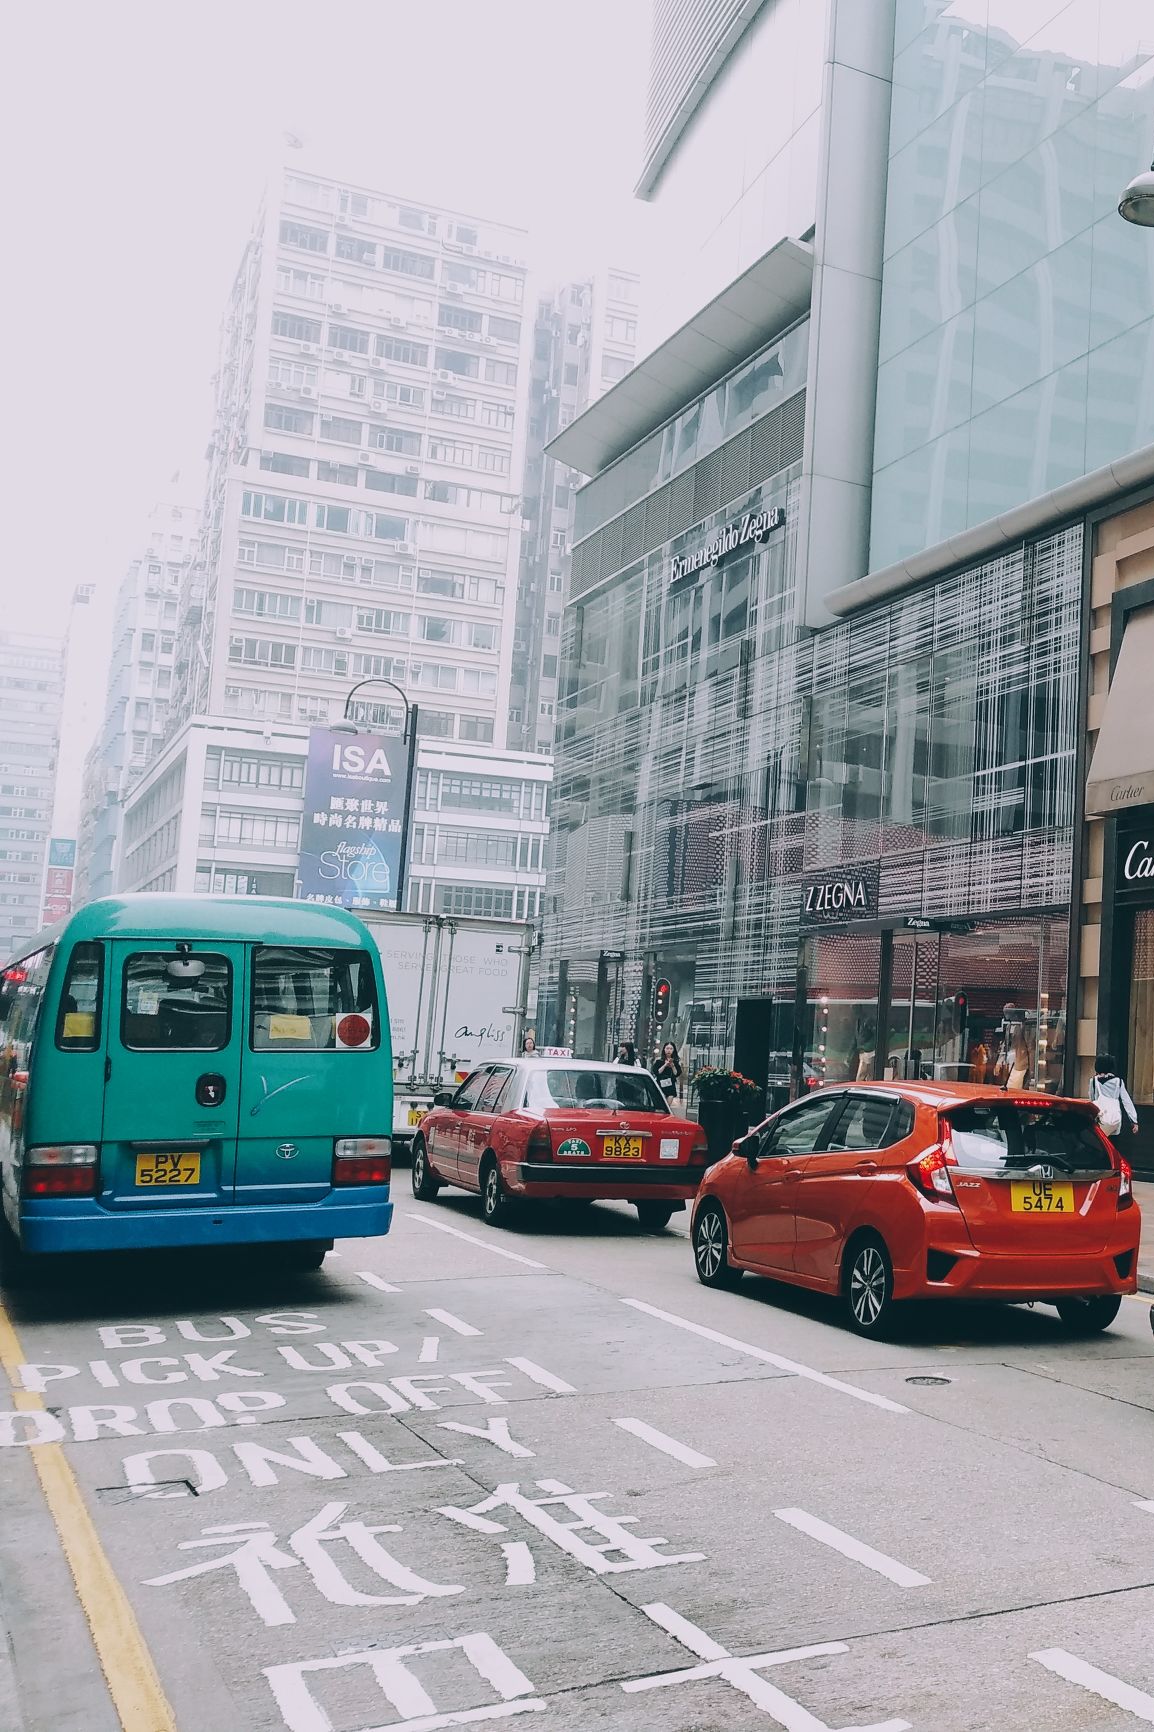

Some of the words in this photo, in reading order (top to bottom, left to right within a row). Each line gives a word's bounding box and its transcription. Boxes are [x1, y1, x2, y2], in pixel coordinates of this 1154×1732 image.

[670, 524, 739, 584] Ermenegildo
[739, 506, 779, 543] Zegna
[332, 744, 392, 776] ISA
[1110, 785, 1145, 802] Cartier
[335, 842, 376, 859] flagship
[319, 850, 390, 883] Store
[805, 886, 815, 911] Z
[816, 881, 866, 911] ZEGNA
[907, 917, 930, 928] Zegna
[483, 957, 508, 967] WHO
[478, 967, 508, 977] FOOD
[547, 1048, 570, 1057] TAXI
[571, 1143, 578, 1151] 5
[613, 1136, 632, 1147] KX
[604, 1146, 641, 1157] 9823
[155, 1155, 183, 1169] PV
[140, 1168, 196, 1184] 5227
[1032, 1181, 1053, 1197] UE
[1023, 1196, 1065, 1211] 5474
[98, 1312, 328, 1349] BUS
[18, 1350, 265, 1392] PICK
[0, 1391, 288, 1447] DROP
[326, 1370, 512, 1416] OFF
[120, 1416, 537, 1499] ONLY
